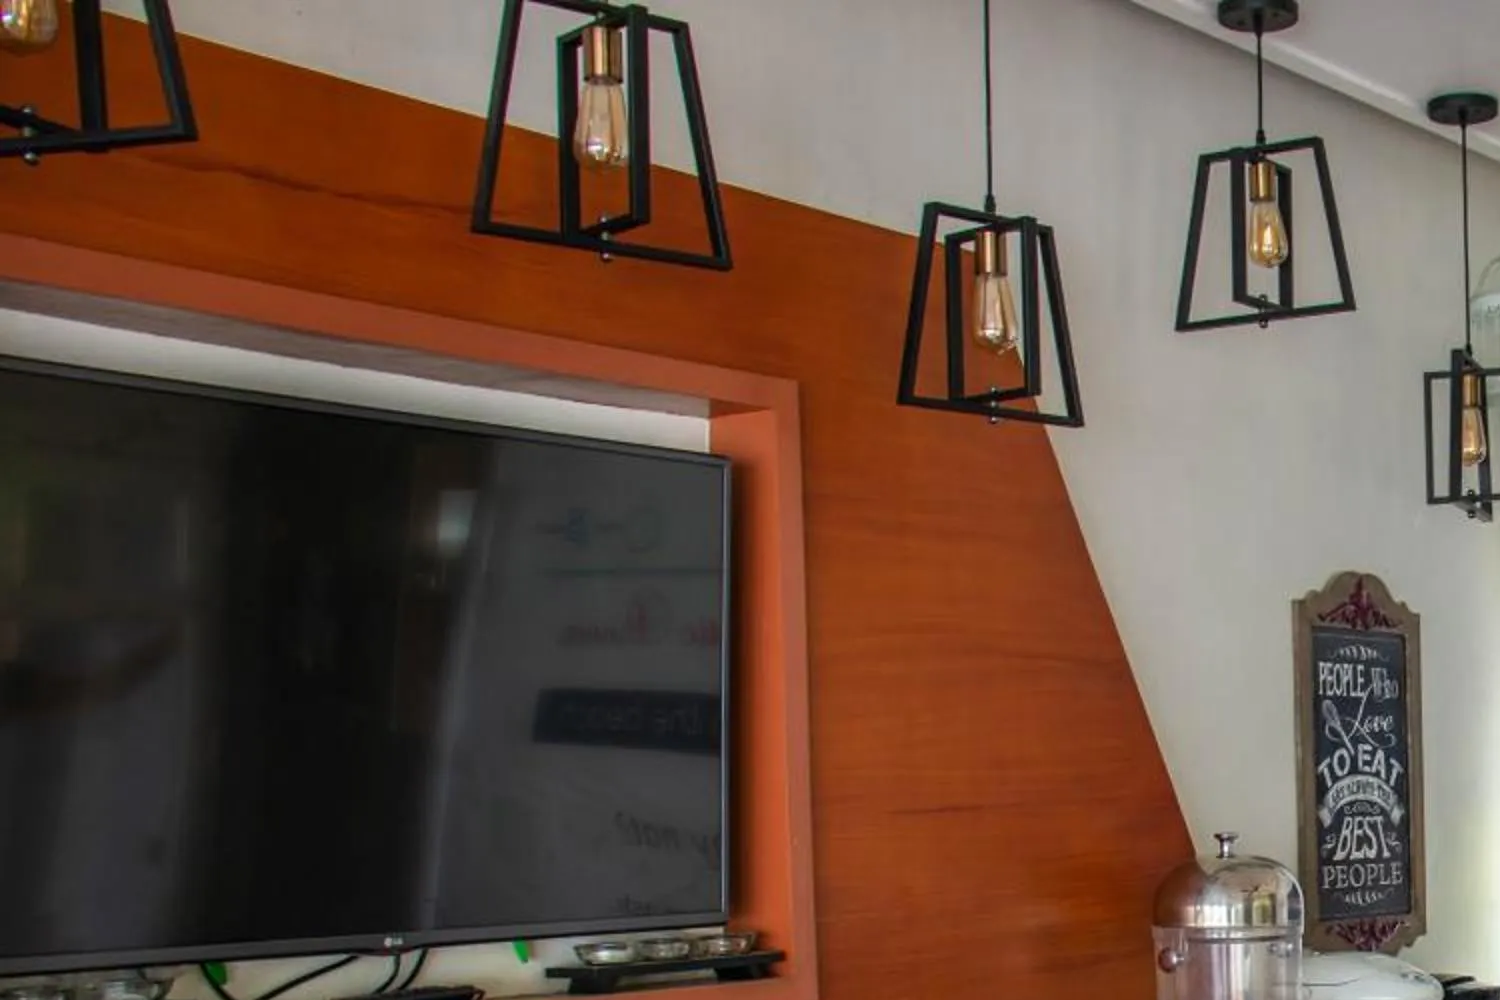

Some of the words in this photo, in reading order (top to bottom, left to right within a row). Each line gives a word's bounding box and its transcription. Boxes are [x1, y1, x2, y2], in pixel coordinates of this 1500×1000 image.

[1318, 661, 1366, 697] PEOPLE
[1318, 748, 1351, 788] TO
[1357, 743, 1404, 787] EAT
[1333, 815, 1392, 861] BEST
[1321, 861, 1404, 890] PEOPLE
